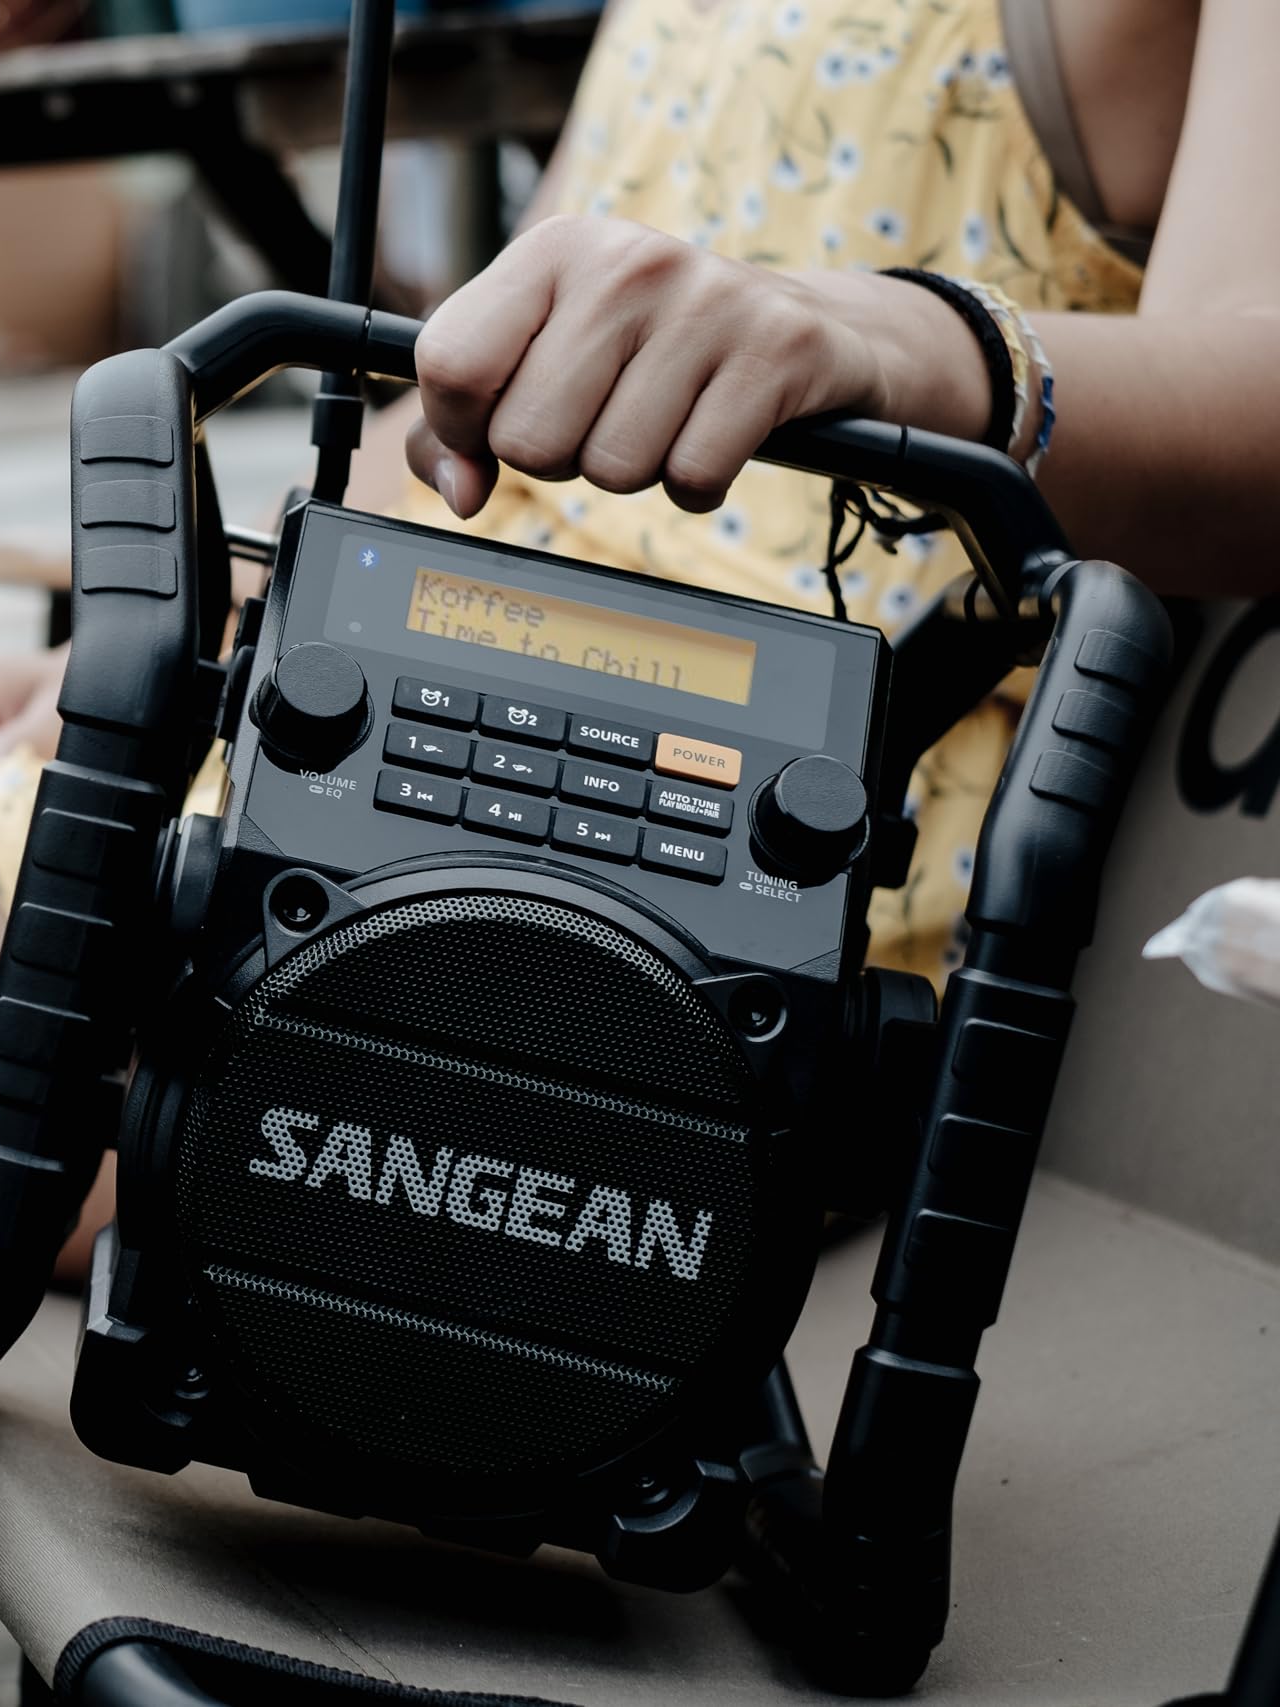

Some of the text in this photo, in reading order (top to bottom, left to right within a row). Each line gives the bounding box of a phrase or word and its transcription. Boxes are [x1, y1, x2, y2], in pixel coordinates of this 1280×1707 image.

[419, 573, 546, 628] Koffee
[416, 607, 684, 690] Time to Chill
[527, 714, 538, 727] 2
[408, 736, 417, 749] 1
[580, 725, 640, 748] SOURCE
[493, 754, 506, 769] 2
[672, 747, 727, 769] POWER
[299, 768, 358, 791] VOLUME
[583, 775, 620, 792] INFO
[325, 787, 343, 801] EQ
[399, 783, 412, 797] 3
[488, 803, 502, 817] 4
[658, 798, 676, 809] PLAY
[660, 790, 721, 811] AUTO TUNE
[576, 822, 589, 837] 5
[660, 842, 705, 862] MENU
[745, 870, 799, 891] TUNING
[754, 884, 803, 903] SELECT
[249, 1106, 713, 1280] SANGEAN
